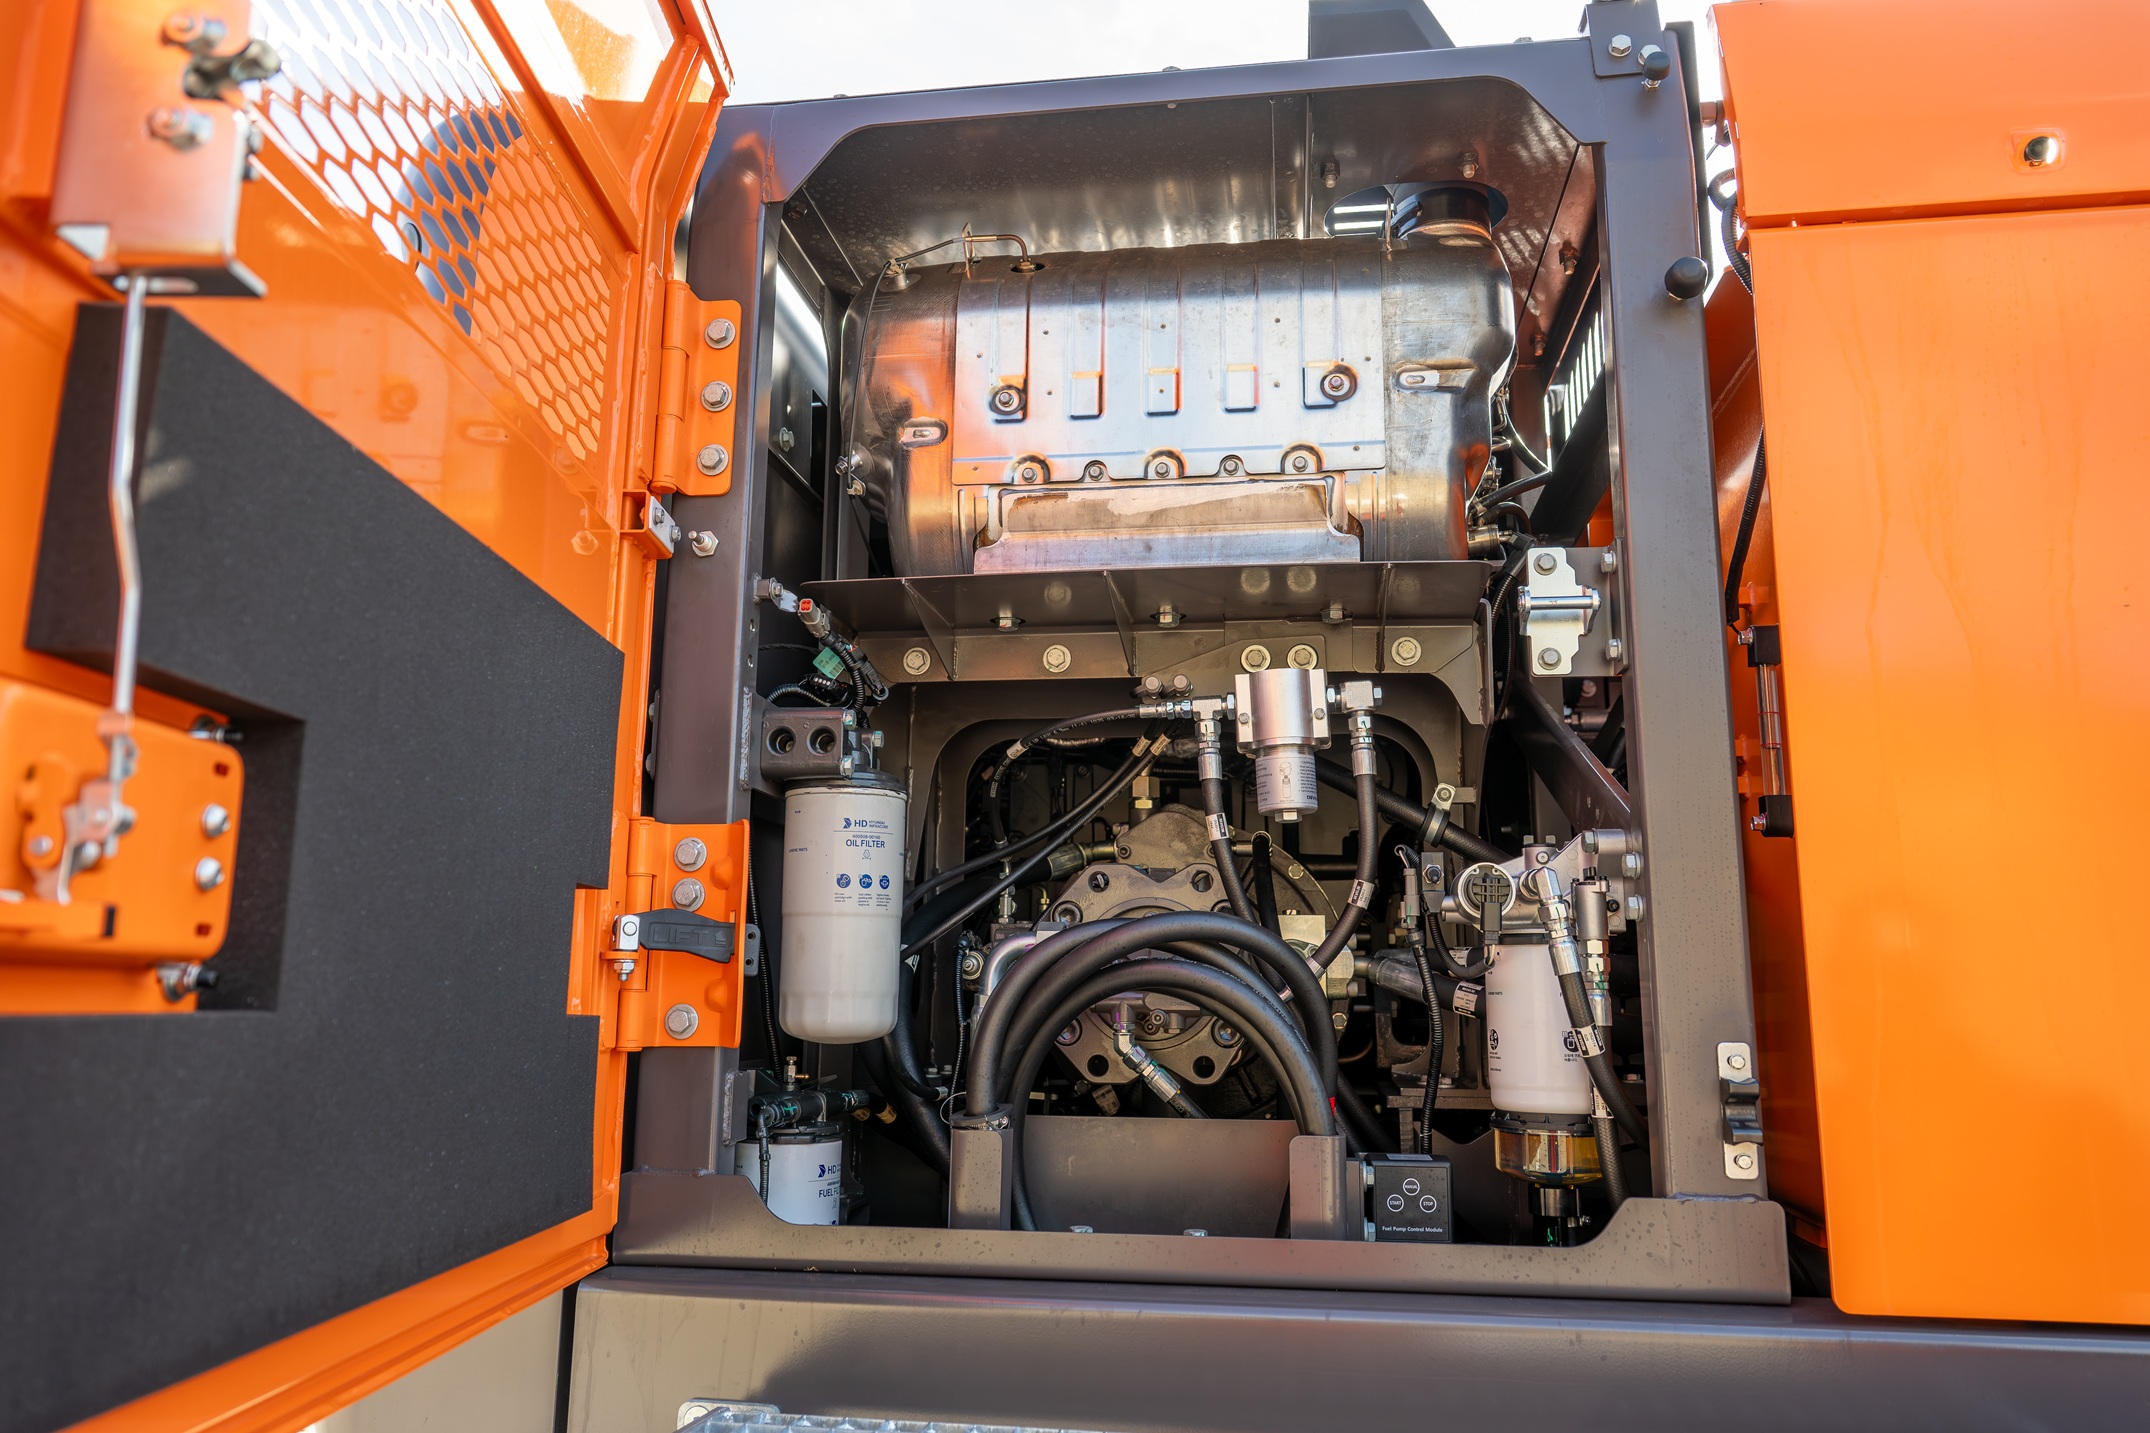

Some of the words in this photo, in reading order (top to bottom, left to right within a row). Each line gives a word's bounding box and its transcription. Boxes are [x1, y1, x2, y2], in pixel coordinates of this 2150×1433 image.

[854, 820, 868, 828] HD
[846, 839, 860, 847] OIL
[860, 839, 886, 848] FILTER
[653, 927, 708, 944] LIFT
[827, 1165, 836, 1174] HD
[819, 1188, 833, 1198] FUEL
